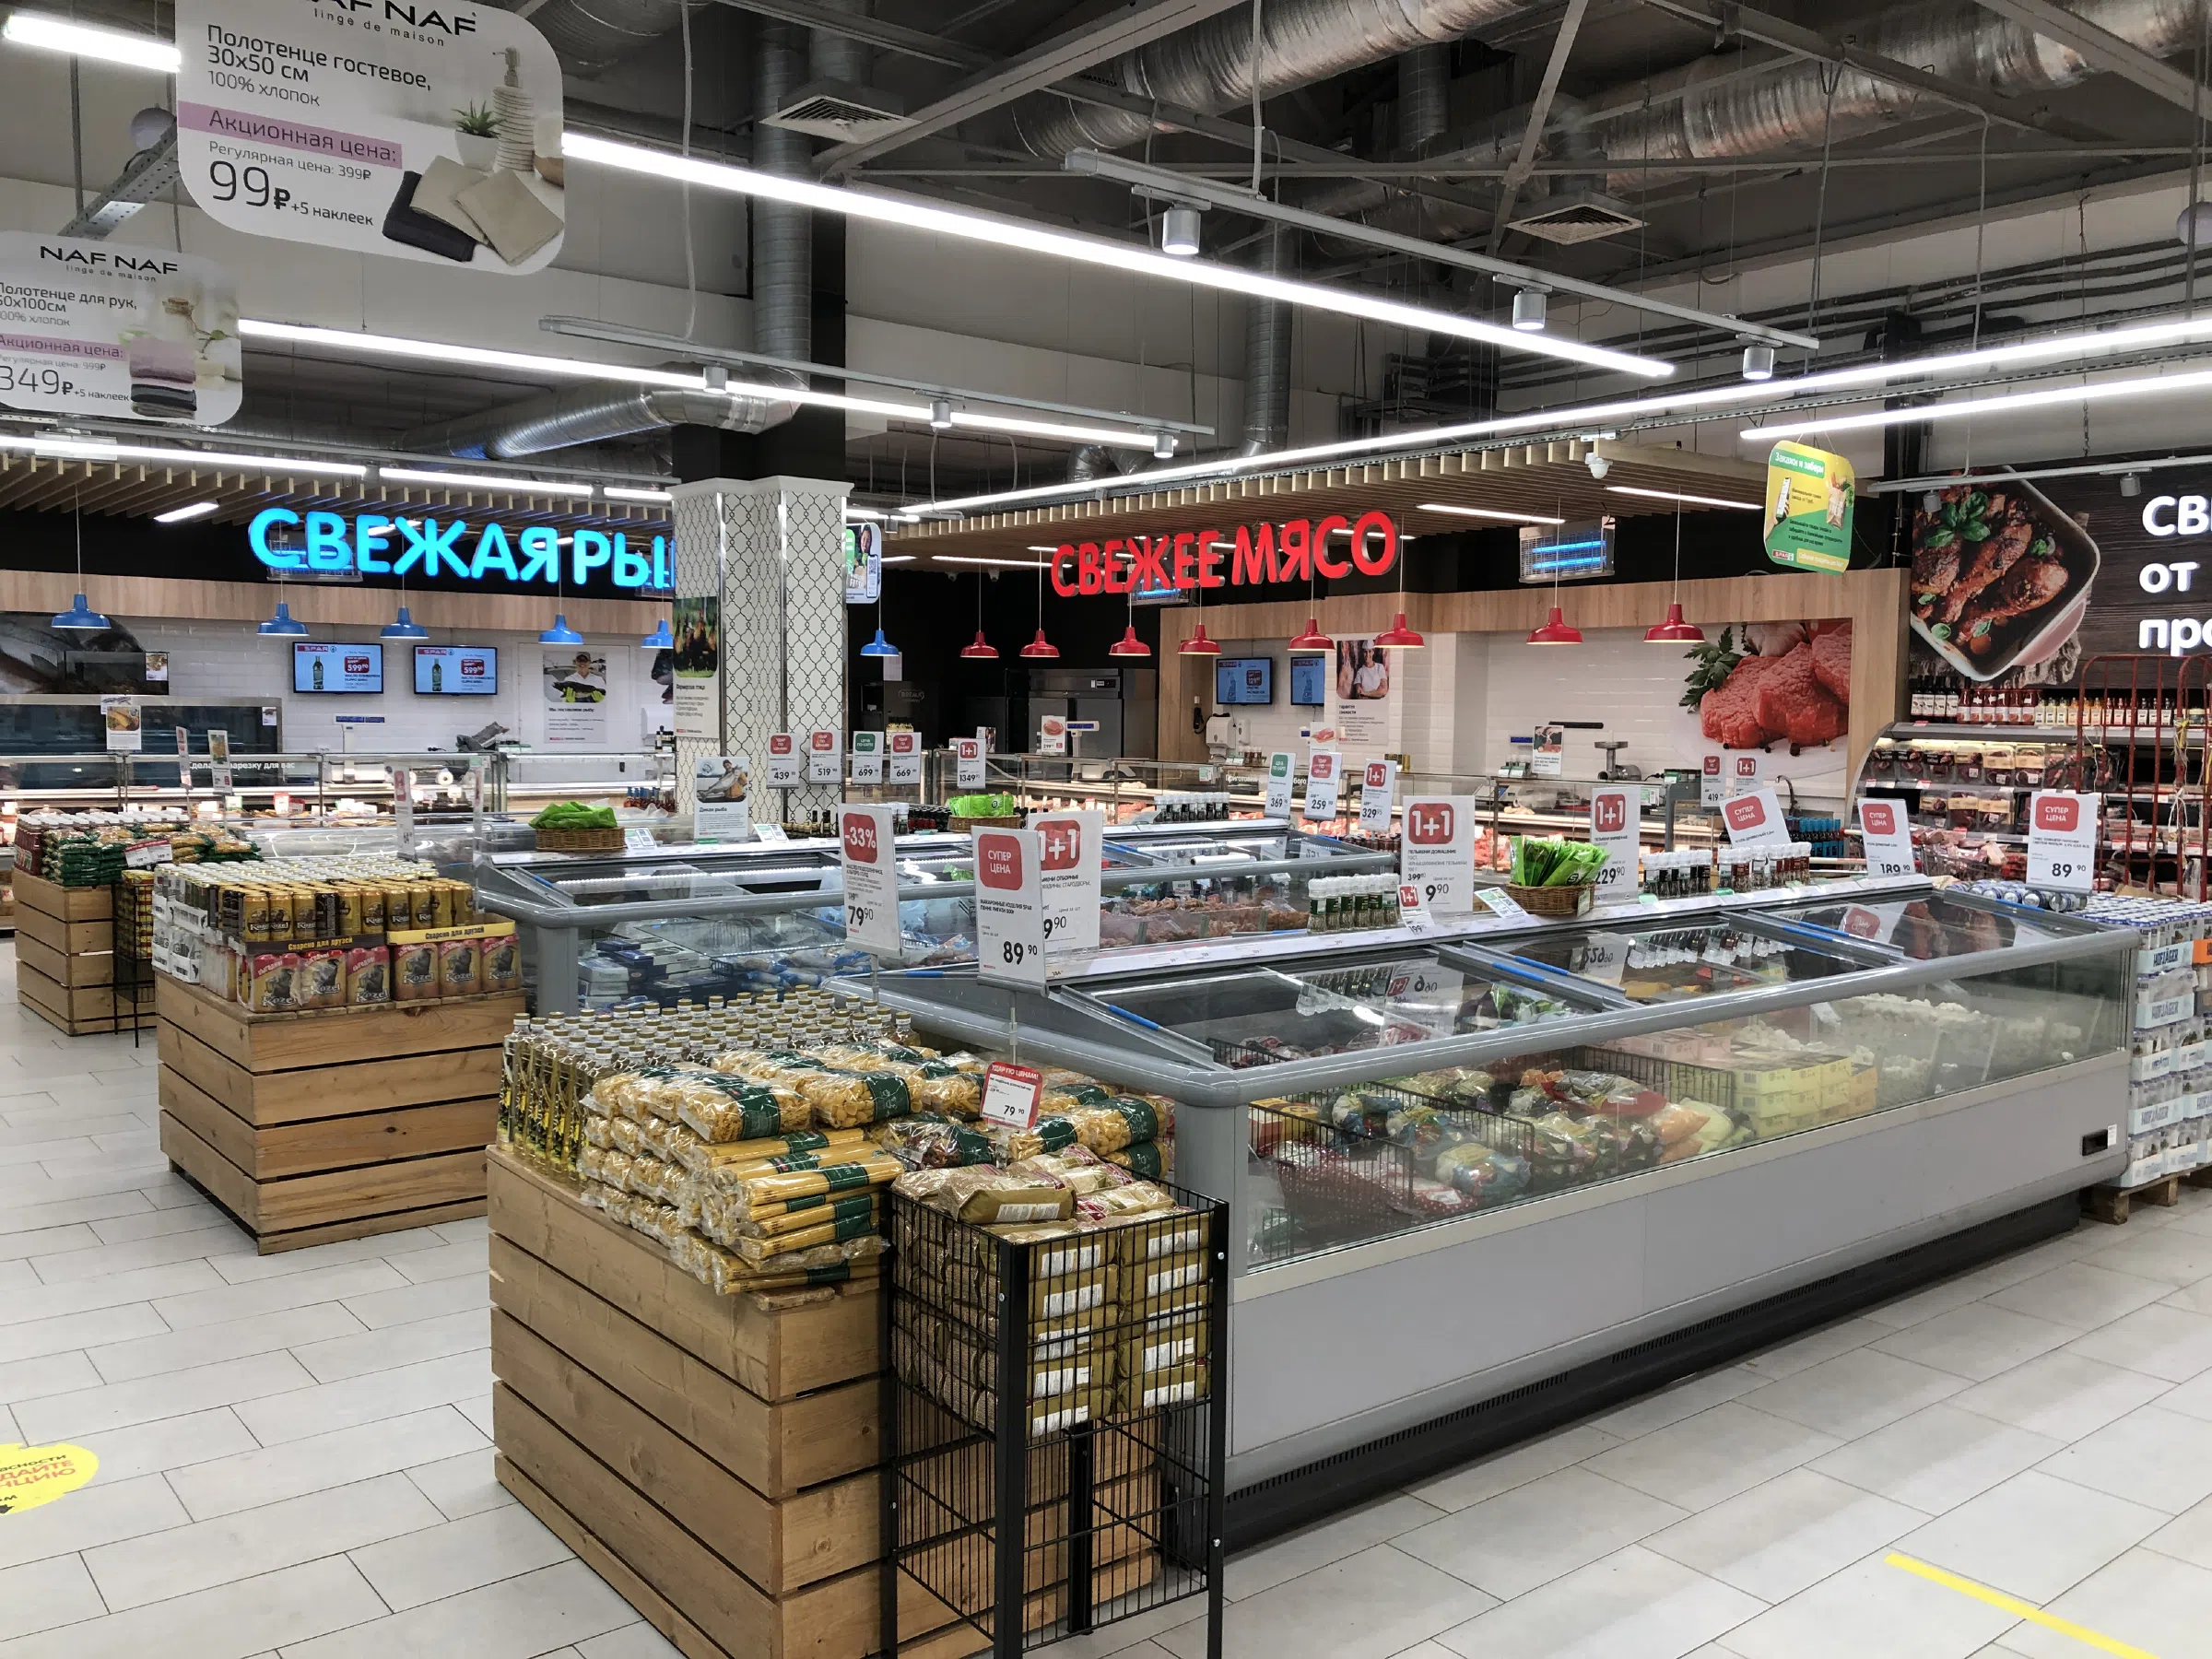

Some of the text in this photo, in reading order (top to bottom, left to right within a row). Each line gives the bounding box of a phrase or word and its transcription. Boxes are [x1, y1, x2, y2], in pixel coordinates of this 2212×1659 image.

[312, 0, 477, 35] AF NAF
[314, 8, 444, 47] linge de maison
[207, 24, 430, 91] Полотенце гостевое,
[281, 65, 309, 82] см
[208, 70, 320, 107] 100% хлопок
[209, 110, 396, 162] Акционная цена:
[209, 141, 293, 167] Регулярная
[298, 159, 335, 174] цена:
[290, 202, 373, 226] +5 наклеек
[40, 245, 178, 275] NAF NAF
[65, 265, 94, 275] linge
[118, 272, 157, 283] maison
[79, 294, 104, 304] для
[109, 297, 137, 310] рук,
[29, 315, 70, 327] хлопок
[0, 335, 124, 359] Акционная цена:
[88, 391, 130, 402] наклеек
[2142, 495, 2212, 536] СВ
[247, 507, 676, 590] СВЕЖАЯ РЫ
[1051, 511, 1401, 597] СВЕЖЕЕ МЯСО
[960, 744, 977, 756] 1+1
[858, 769, 873, 777] 699
[1738, 760, 1755, 773] 1+1
[1368, 767, 1385, 783] 1+1
[1271, 797, 1283, 807] 369
[1312, 799, 1326, 809] 259
[1708, 794, 1719, 802] 419
[1362, 808, 1376, 818] 329
[1597, 800, 1624, 825] 1+1
[1734, 805, 1754, 816] СУПЕР
[2045, 806, 2069, 814] СУПЕР
[1412, 810, 1450, 836] 1+1
[1737, 814, 1756, 822] ЦЕНА
[2045, 814, 2066, 822] ЦЕНА
[844, 827, 877, 850] -33%
[1040, 829, 1077, 862] 1+1
[988, 850, 1012, 862] СУПЕР
[990, 863, 1011, 875] ЦЕНА
[1880, 864, 1900, 874] 189
[2052, 863, 2072, 877] 89
[1401, 888, 1418, 902] 1+1
[1437, 884, 1449, 894] 90
[848, 905, 864, 926] 79
[1054, 916, 1066, 929] 90
[288, 936, 353, 950] Сварено для друзей
[1004, 941, 1037, 965] 89 90
[403, 972, 434, 983] Kozel
[445, 971, 475, 982] Kozel
[488, 970, 516, 981] Kozel
[355, 990, 388, 1003] Kozel
[992, 1065, 1006, 1073] УДАР
[1016, 1070, 1039, 1080] ЦЕНАМ!
[1004, 1104, 1016, 1116] 79
